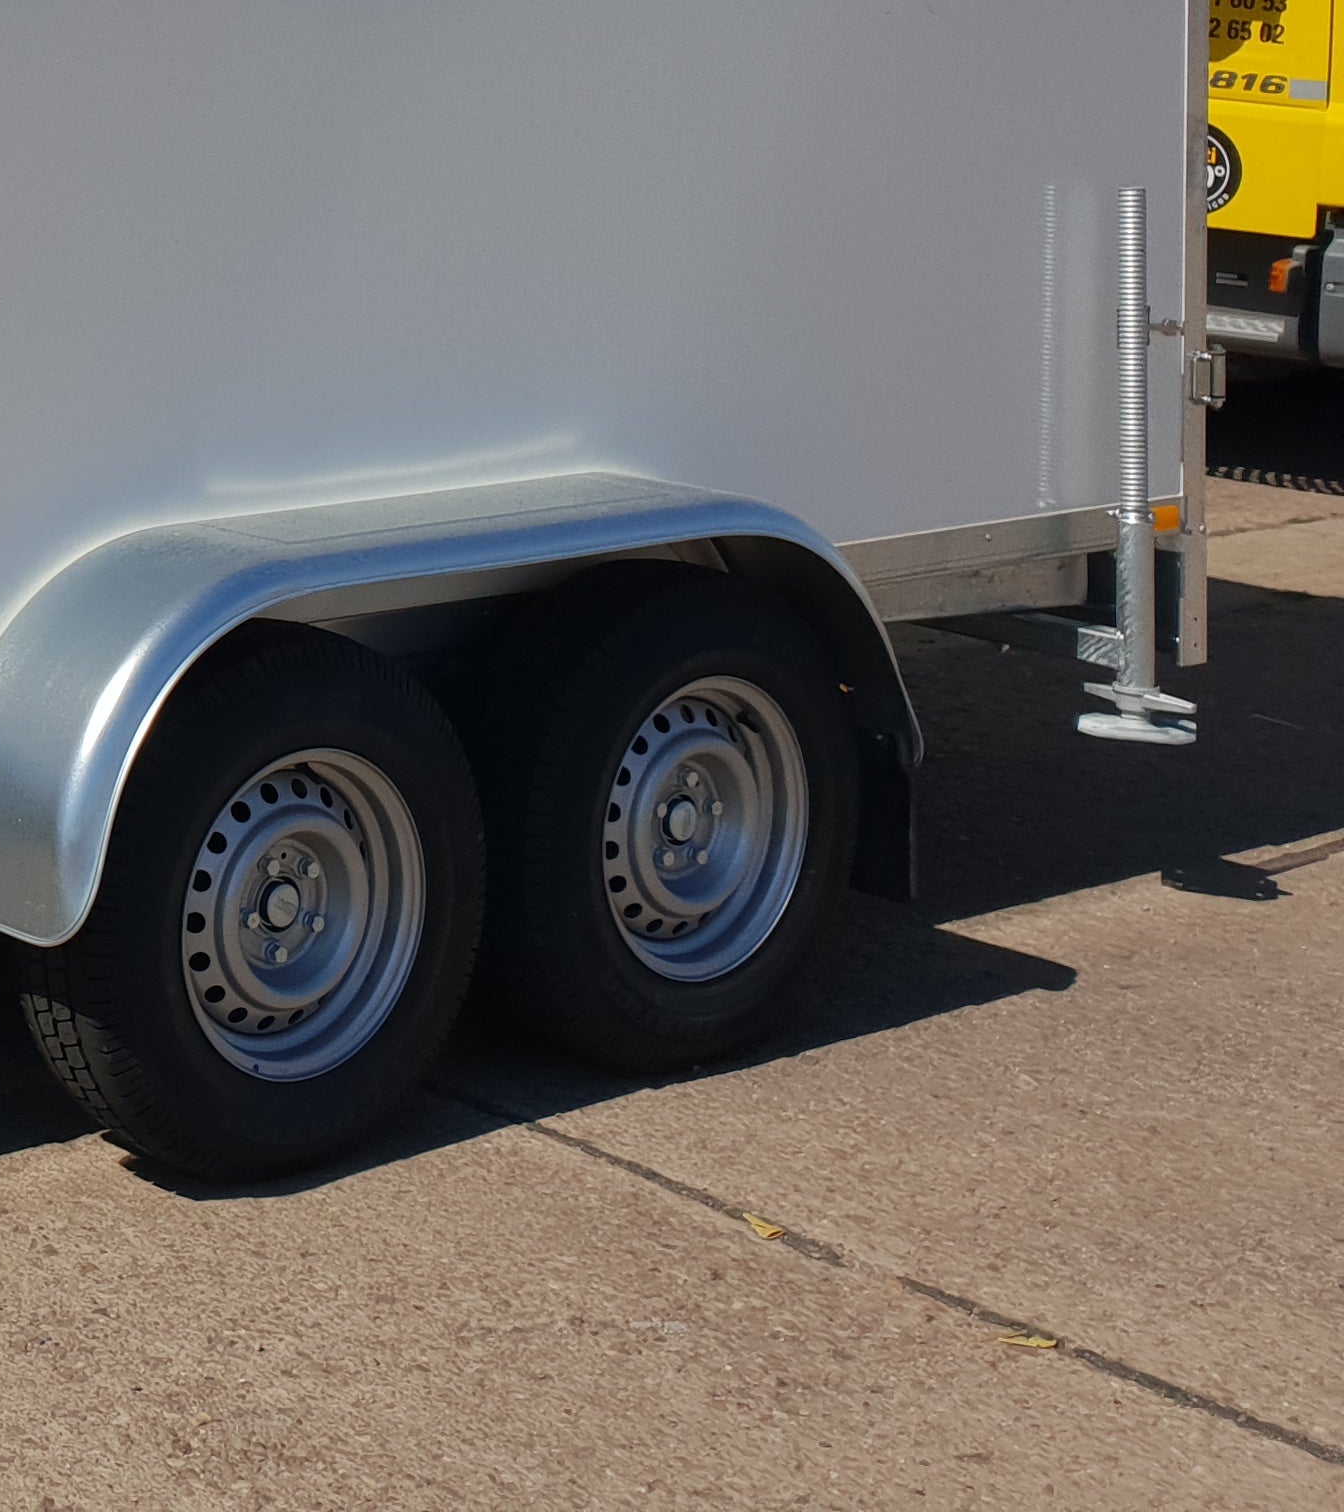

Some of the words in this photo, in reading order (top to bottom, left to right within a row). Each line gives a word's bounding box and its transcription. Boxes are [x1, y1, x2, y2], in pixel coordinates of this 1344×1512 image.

[1208, 16, 1222, 39] 2
[1226, 18, 1252, 41] 65
[1260, 21, 1285, 46] 02
[1209, 69, 1289, 95] 816
